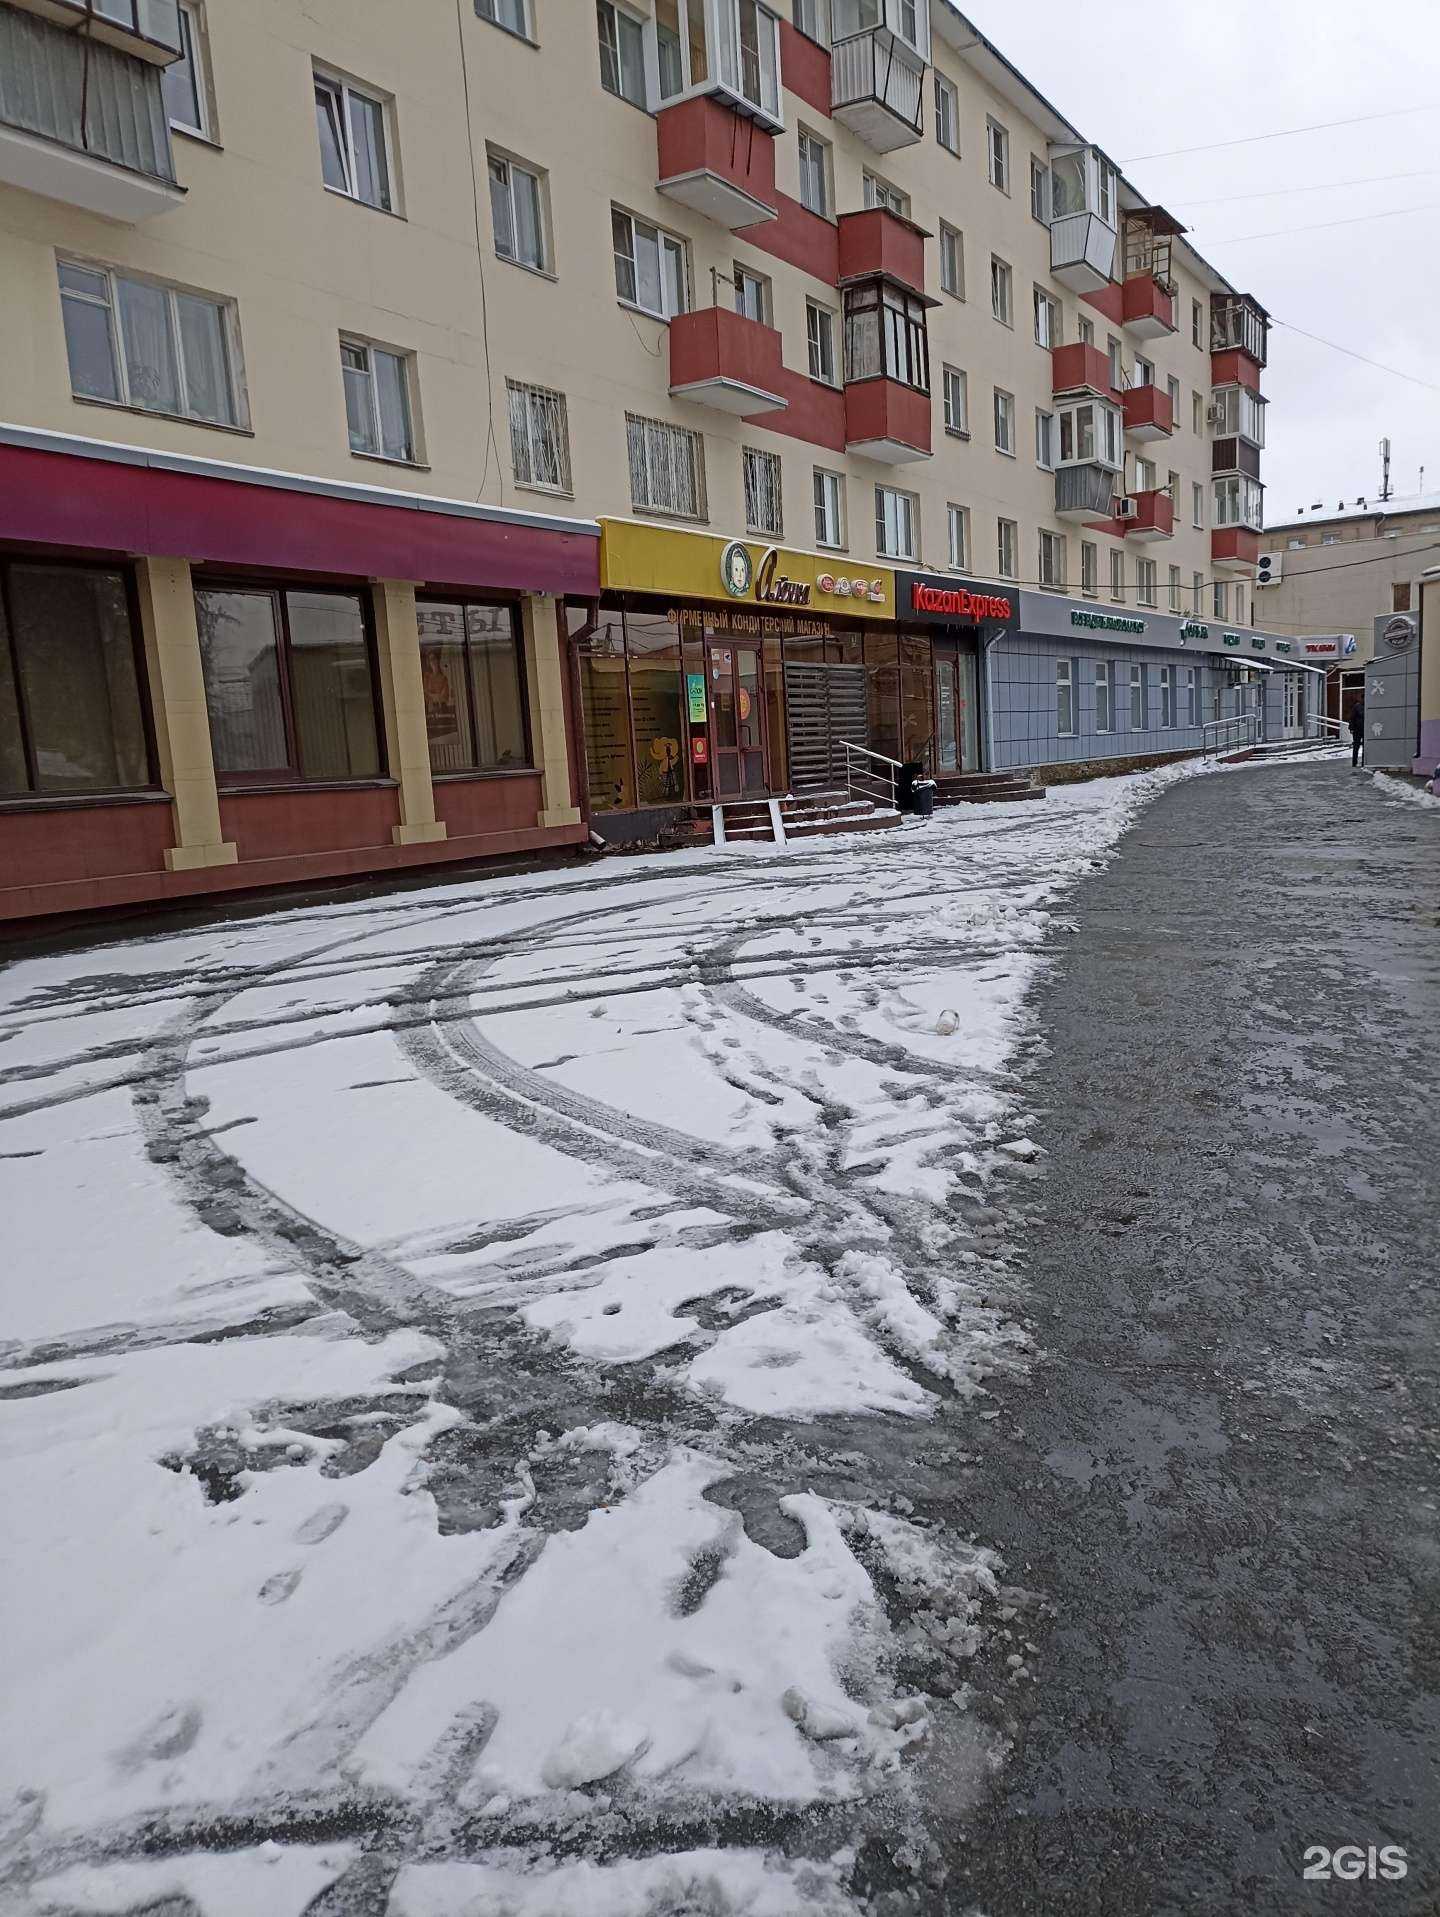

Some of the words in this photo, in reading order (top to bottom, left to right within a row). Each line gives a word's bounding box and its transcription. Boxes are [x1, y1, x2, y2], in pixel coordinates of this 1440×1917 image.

[912, 582, 1012, 623] KazanExpress
[666, 607, 729, 629] ФИРМЕННЫЙ
[731, 613, 795, 634] КОНДИТЕРСКИЙ
[797, 619, 831, 636] МАГАЗИН
